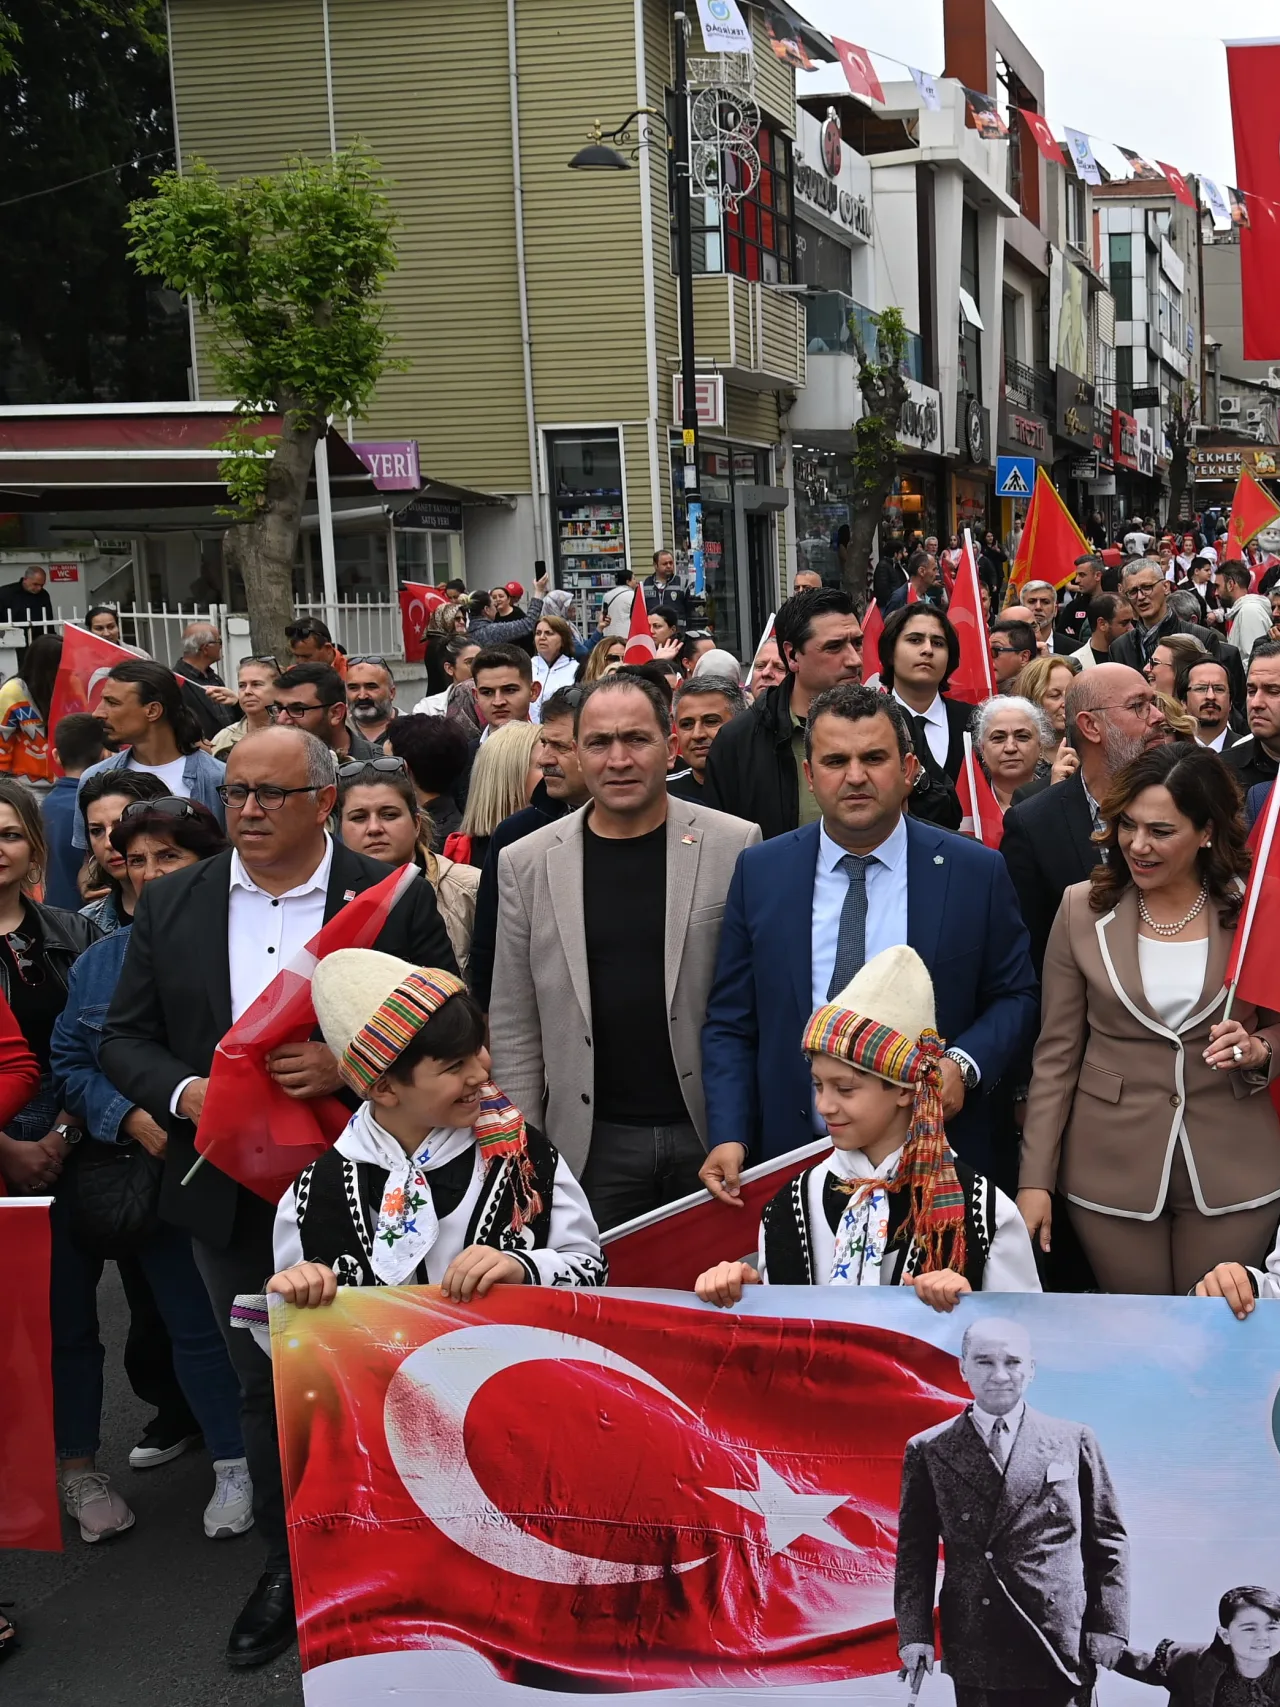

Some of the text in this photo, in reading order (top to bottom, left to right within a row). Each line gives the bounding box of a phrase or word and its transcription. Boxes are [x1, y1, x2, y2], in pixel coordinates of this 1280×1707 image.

[367, 446, 413, 477] YERİ
[1197, 452, 1242, 463] EKMEK
[1194, 464, 1242, 475] TEKNES
[57, 570, 70, 578] WC
